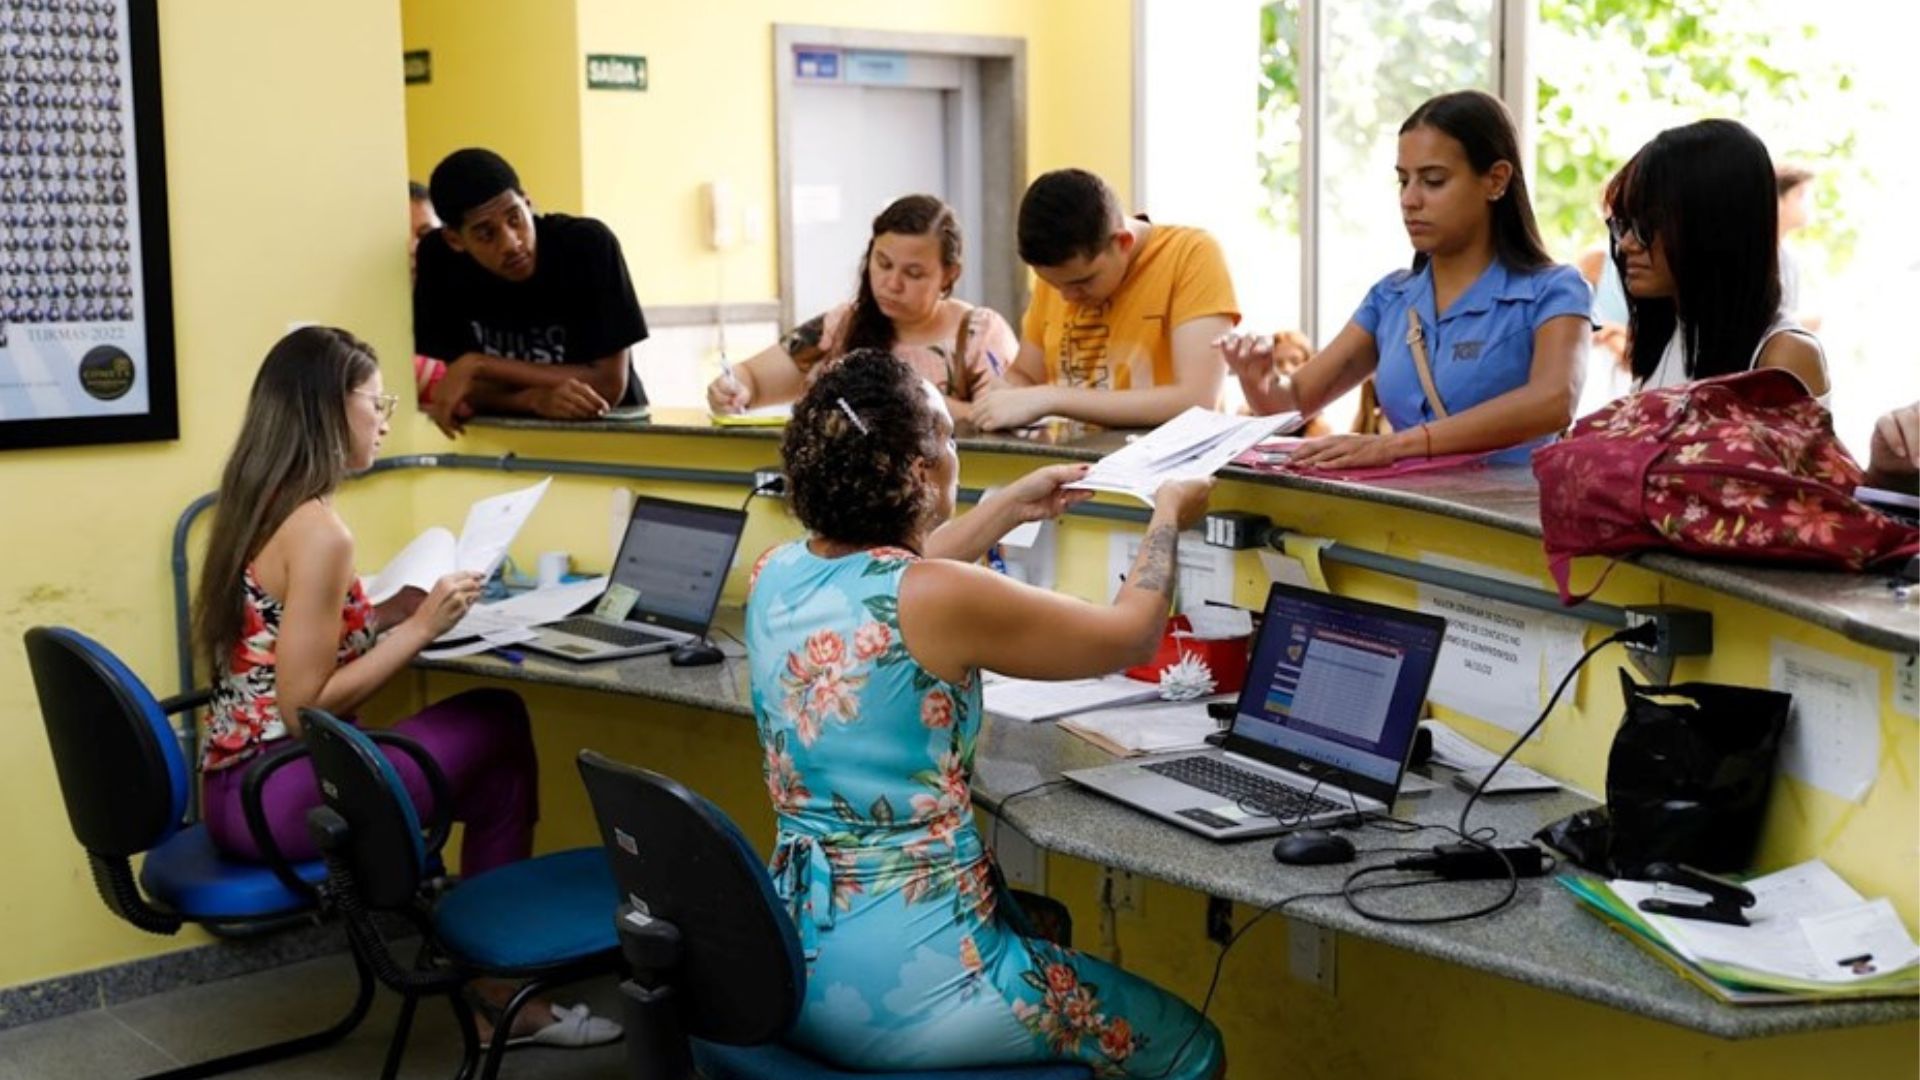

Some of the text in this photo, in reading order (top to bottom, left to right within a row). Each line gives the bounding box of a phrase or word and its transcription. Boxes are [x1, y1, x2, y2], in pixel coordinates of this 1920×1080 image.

[590, 58, 637, 83] SAÍDA
[27, 327, 125, 344] TURMAS 2022
